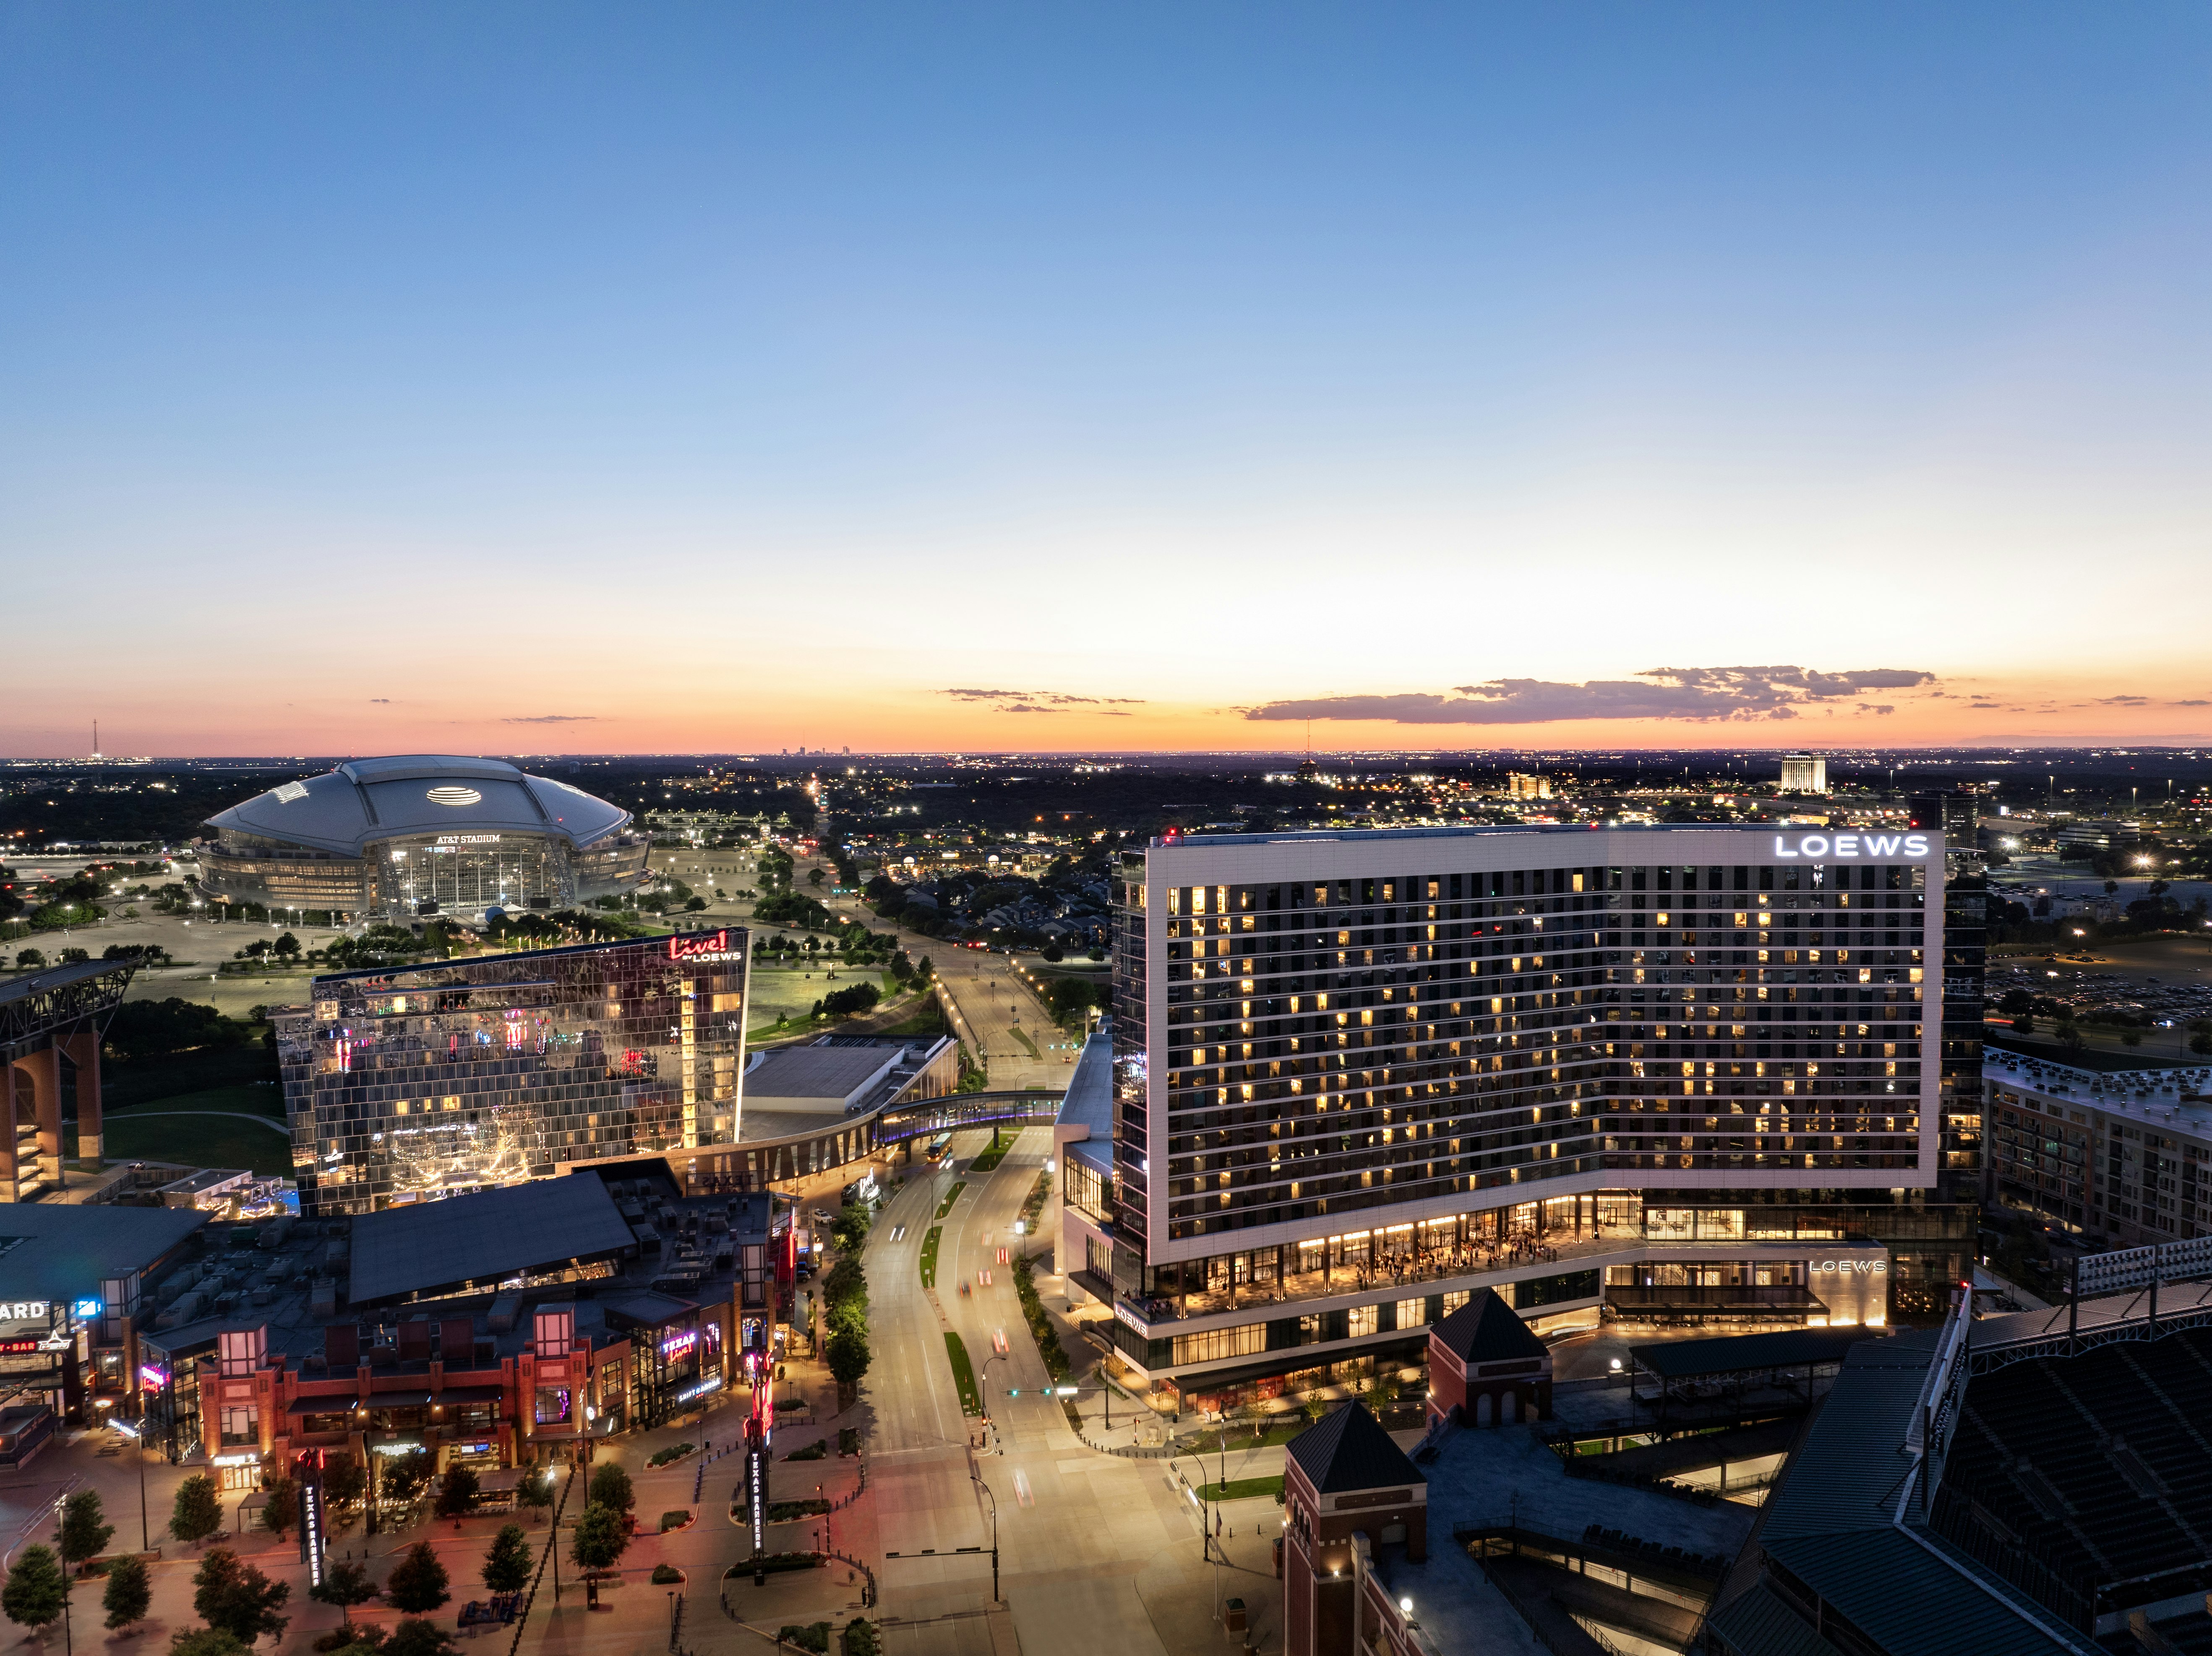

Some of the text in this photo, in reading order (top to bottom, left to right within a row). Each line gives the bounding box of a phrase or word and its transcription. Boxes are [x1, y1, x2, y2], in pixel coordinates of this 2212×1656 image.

[461, 835, 500, 843] STADIUM
[1776, 836, 1928, 856] LOEWS
[670, 930, 726, 959] Live!
[693, 952, 741, 962] LOEWS
[1810, 1261, 1886, 1271] LOEWS
[0, 1303, 44, 1319] ARD
[1115, 1304, 1147, 1336] LOEWS
[663, 1333, 695, 1353] TEXAS
[670, 1342, 691, 1362] Live!
[306, 1487, 315, 1528] TEXAS
[310, 1531, 319, 1586] RANGERS
